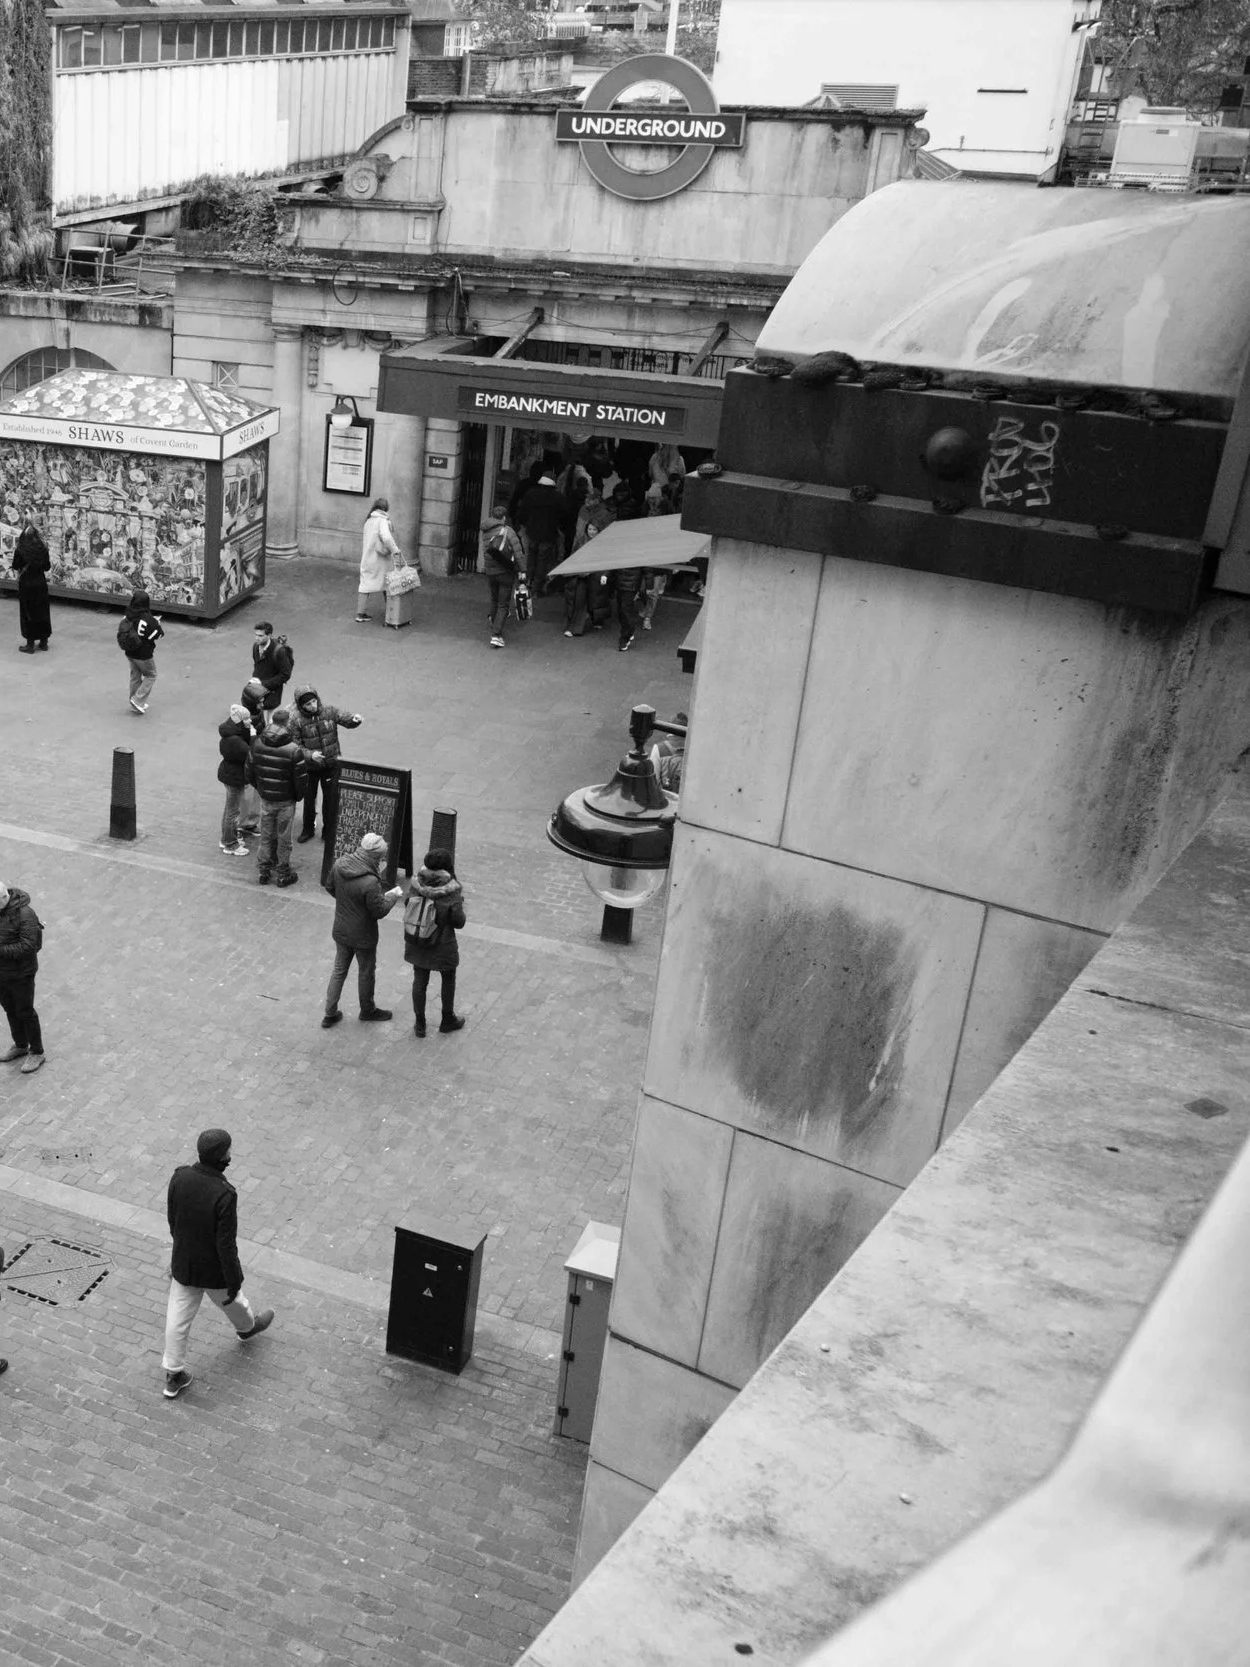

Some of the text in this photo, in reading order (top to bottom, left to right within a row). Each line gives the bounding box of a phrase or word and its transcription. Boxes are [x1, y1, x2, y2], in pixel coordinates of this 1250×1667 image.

[571, 117, 726, 138] UNDERGROUND
[475, 393, 666, 426] EMBANKMENT STATION
[2, 422, 45, 434] Established
[68, 426, 124, 444] SHAWS
[130, 436, 139, 445] of
[140, 437, 167, 447] Covent
[169, 440, 198, 450] Garden
[239, 421, 265, 444] SHAWS
[341, 768, 399, 786] BLUES & ROYALS
[340, 788, 396, 807] PLEASE SUPPORT
[341, 807, 392, 822] INDEPENDENT
[337, 824, 360, 837] SINCE
